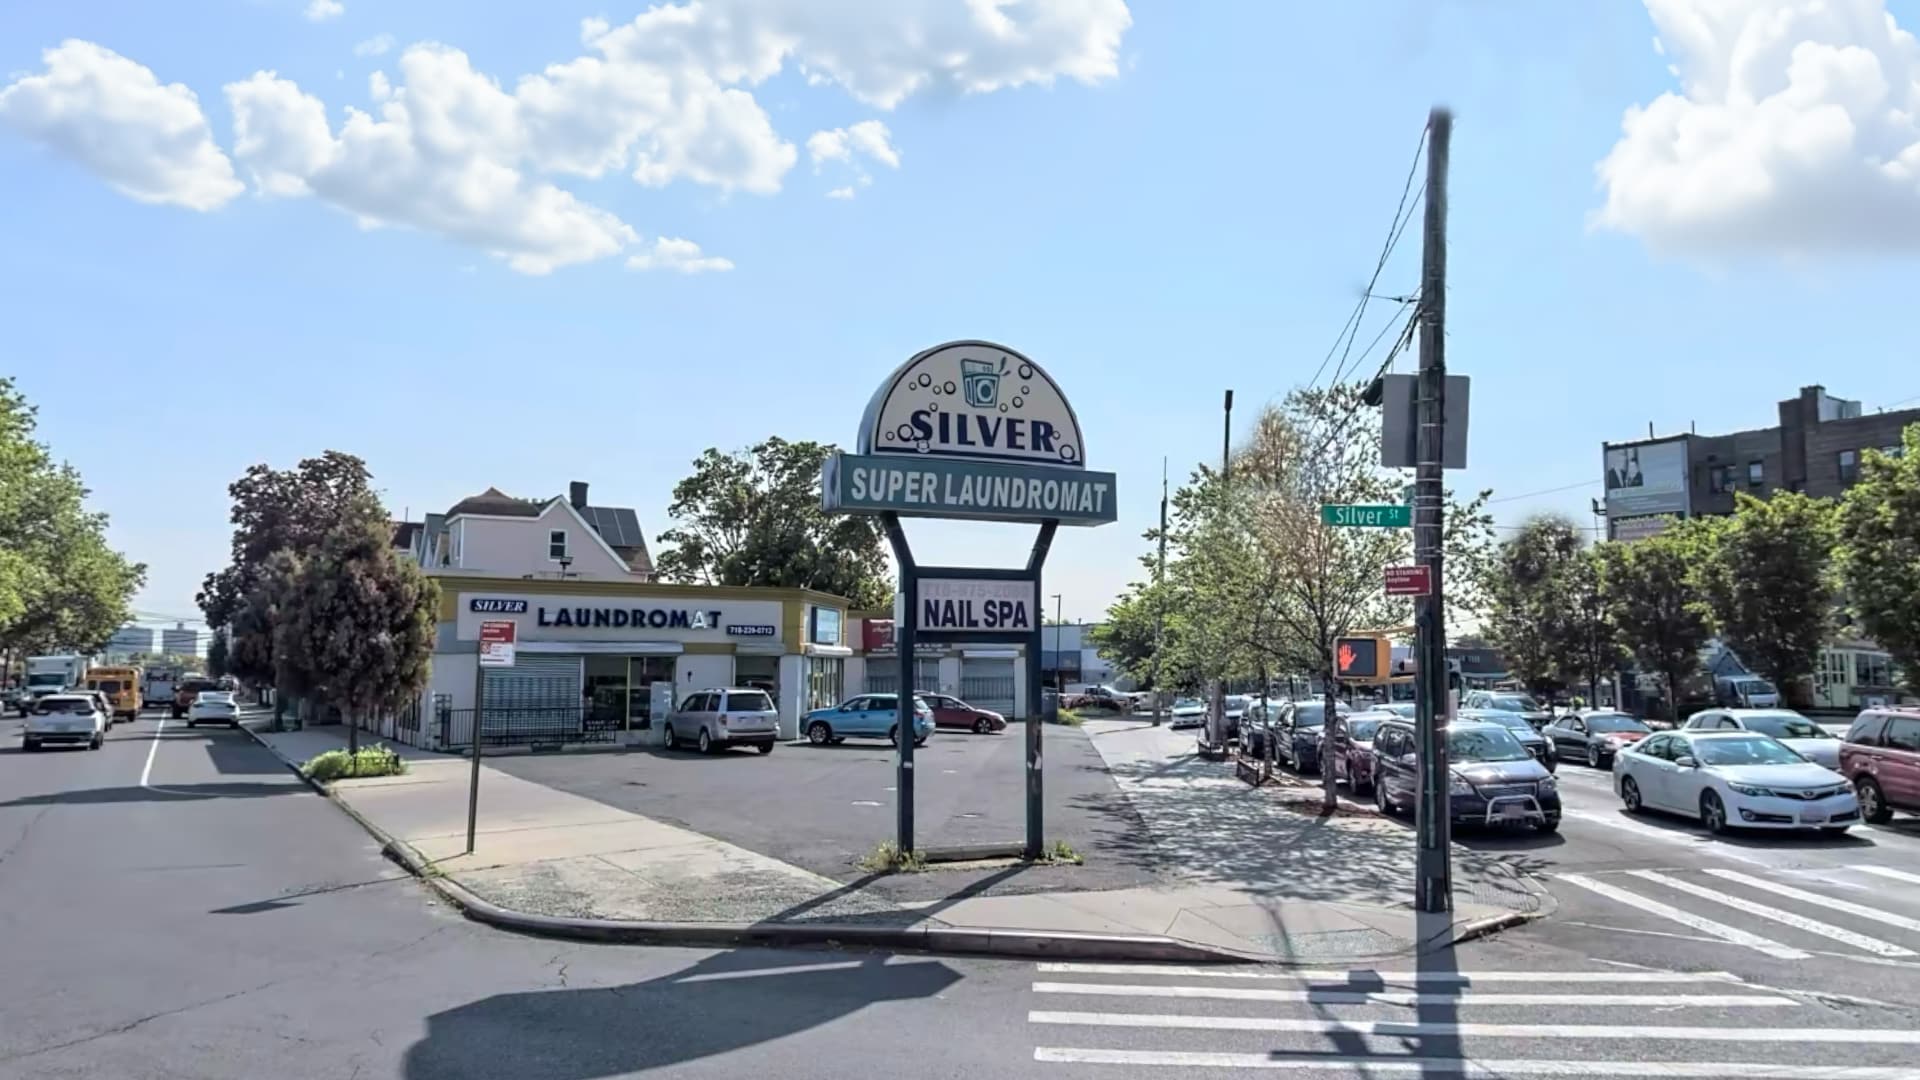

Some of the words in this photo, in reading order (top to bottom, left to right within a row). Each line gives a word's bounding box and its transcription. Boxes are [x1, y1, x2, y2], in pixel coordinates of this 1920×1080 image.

[910, 409, 1055, 453] SILVER
[851, 467, 937, 504] SUPER
[944, 473, 1107, 513] LAUNDROMAT
[1336, 507, 1382, 524] Silver
[1389, 508, 1399, 519] St
[474, 600, 524, 612] SILVER
[537, 607, 722, 631] LAUNDROMAT
[924, 599, 979, 628] NAIL
[983, 600, 1028, 628] SPA
